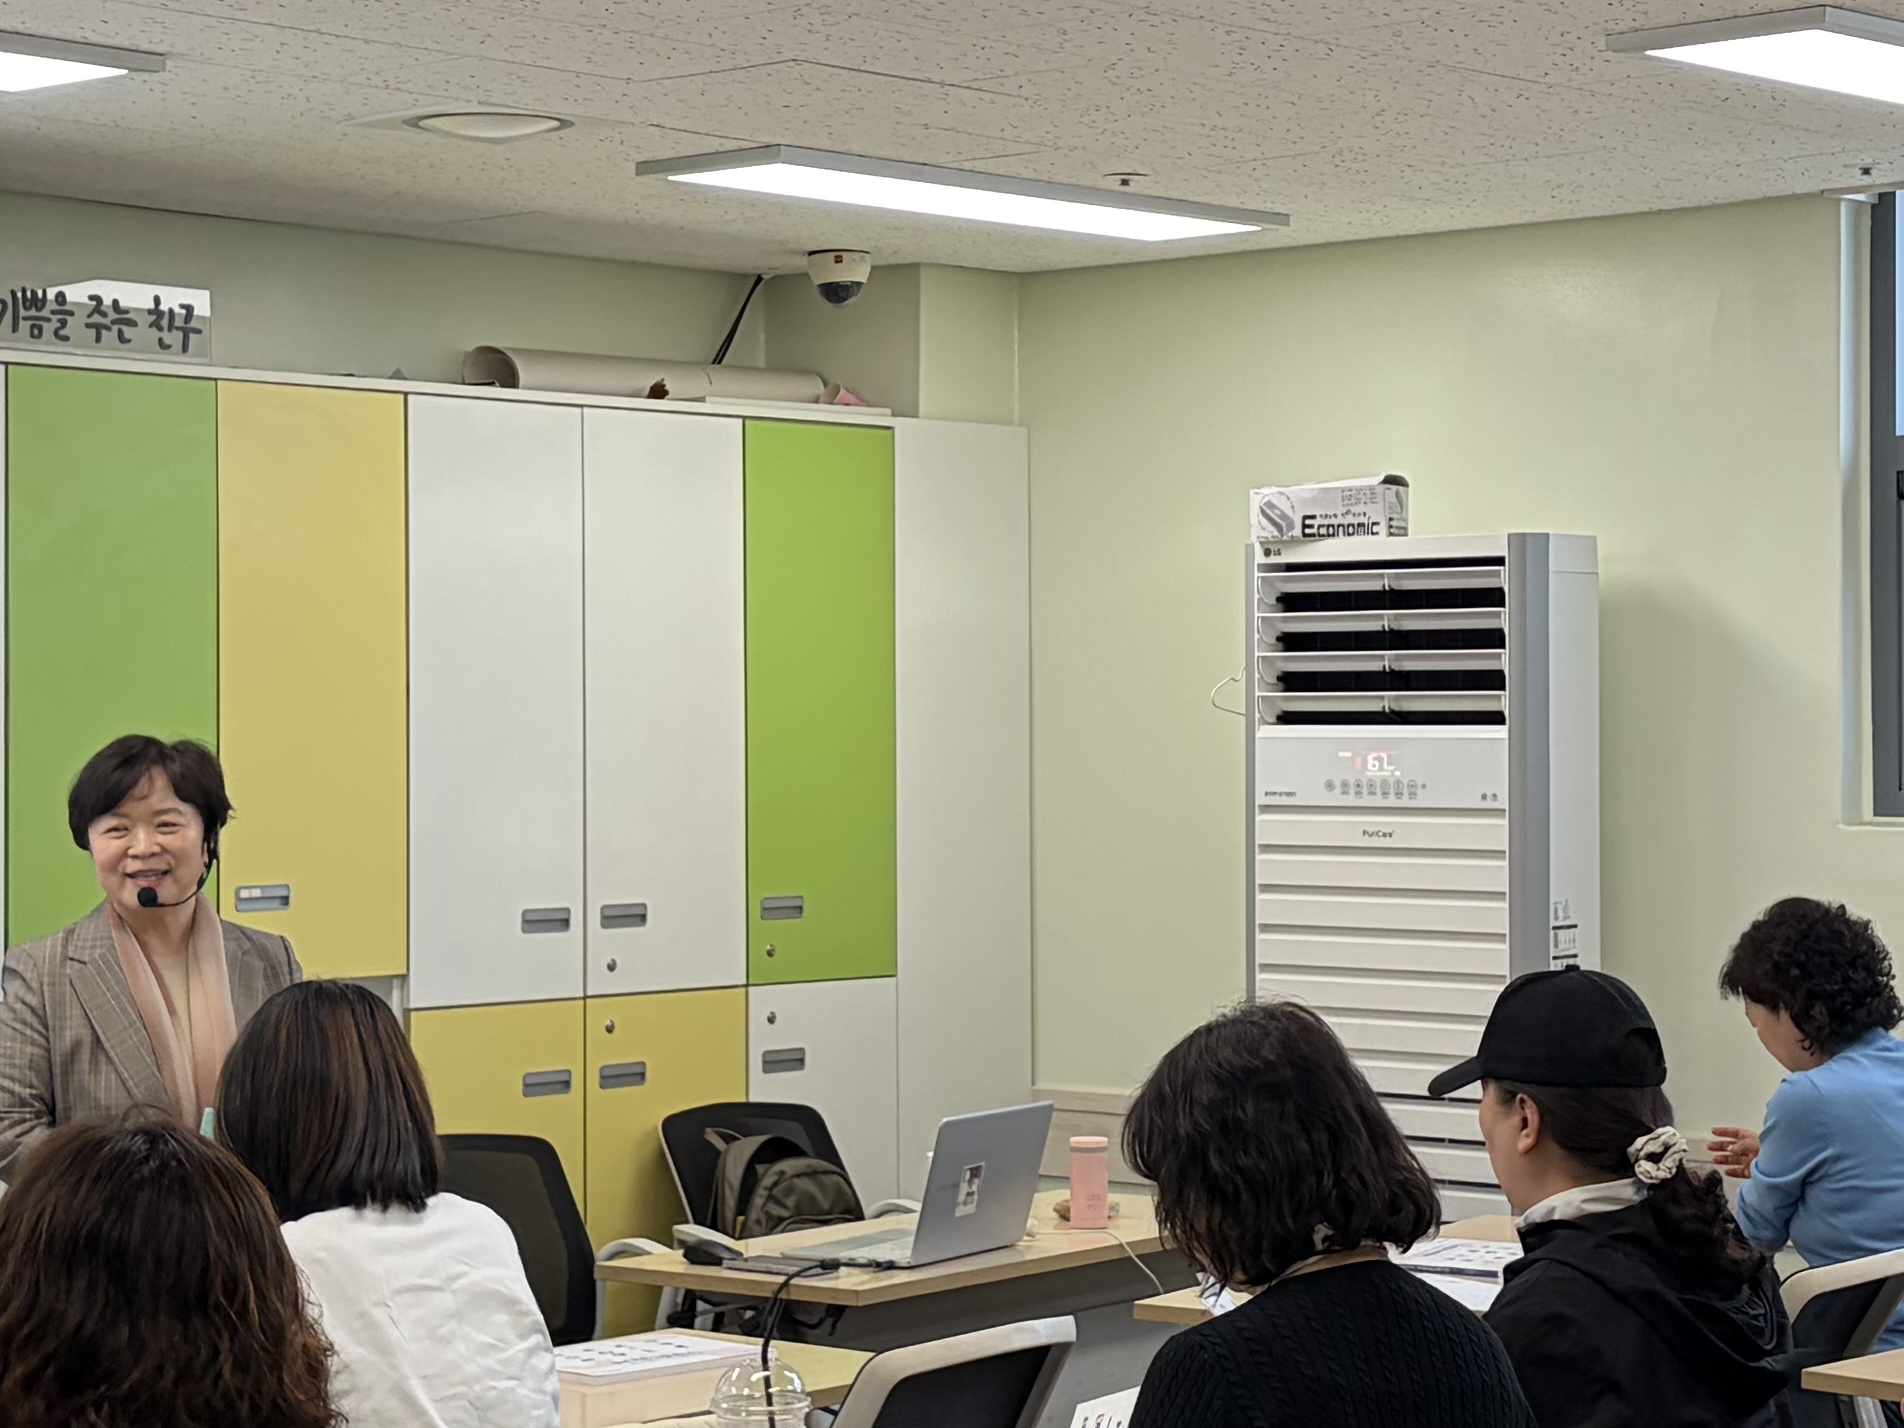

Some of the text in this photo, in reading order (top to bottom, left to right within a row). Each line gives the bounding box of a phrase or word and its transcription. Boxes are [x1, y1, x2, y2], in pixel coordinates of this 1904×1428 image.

[84, 294, 139, 344] 주는
[147, 293, 203, 354] 친구
[1301, 514, 1381, 539] Economic
